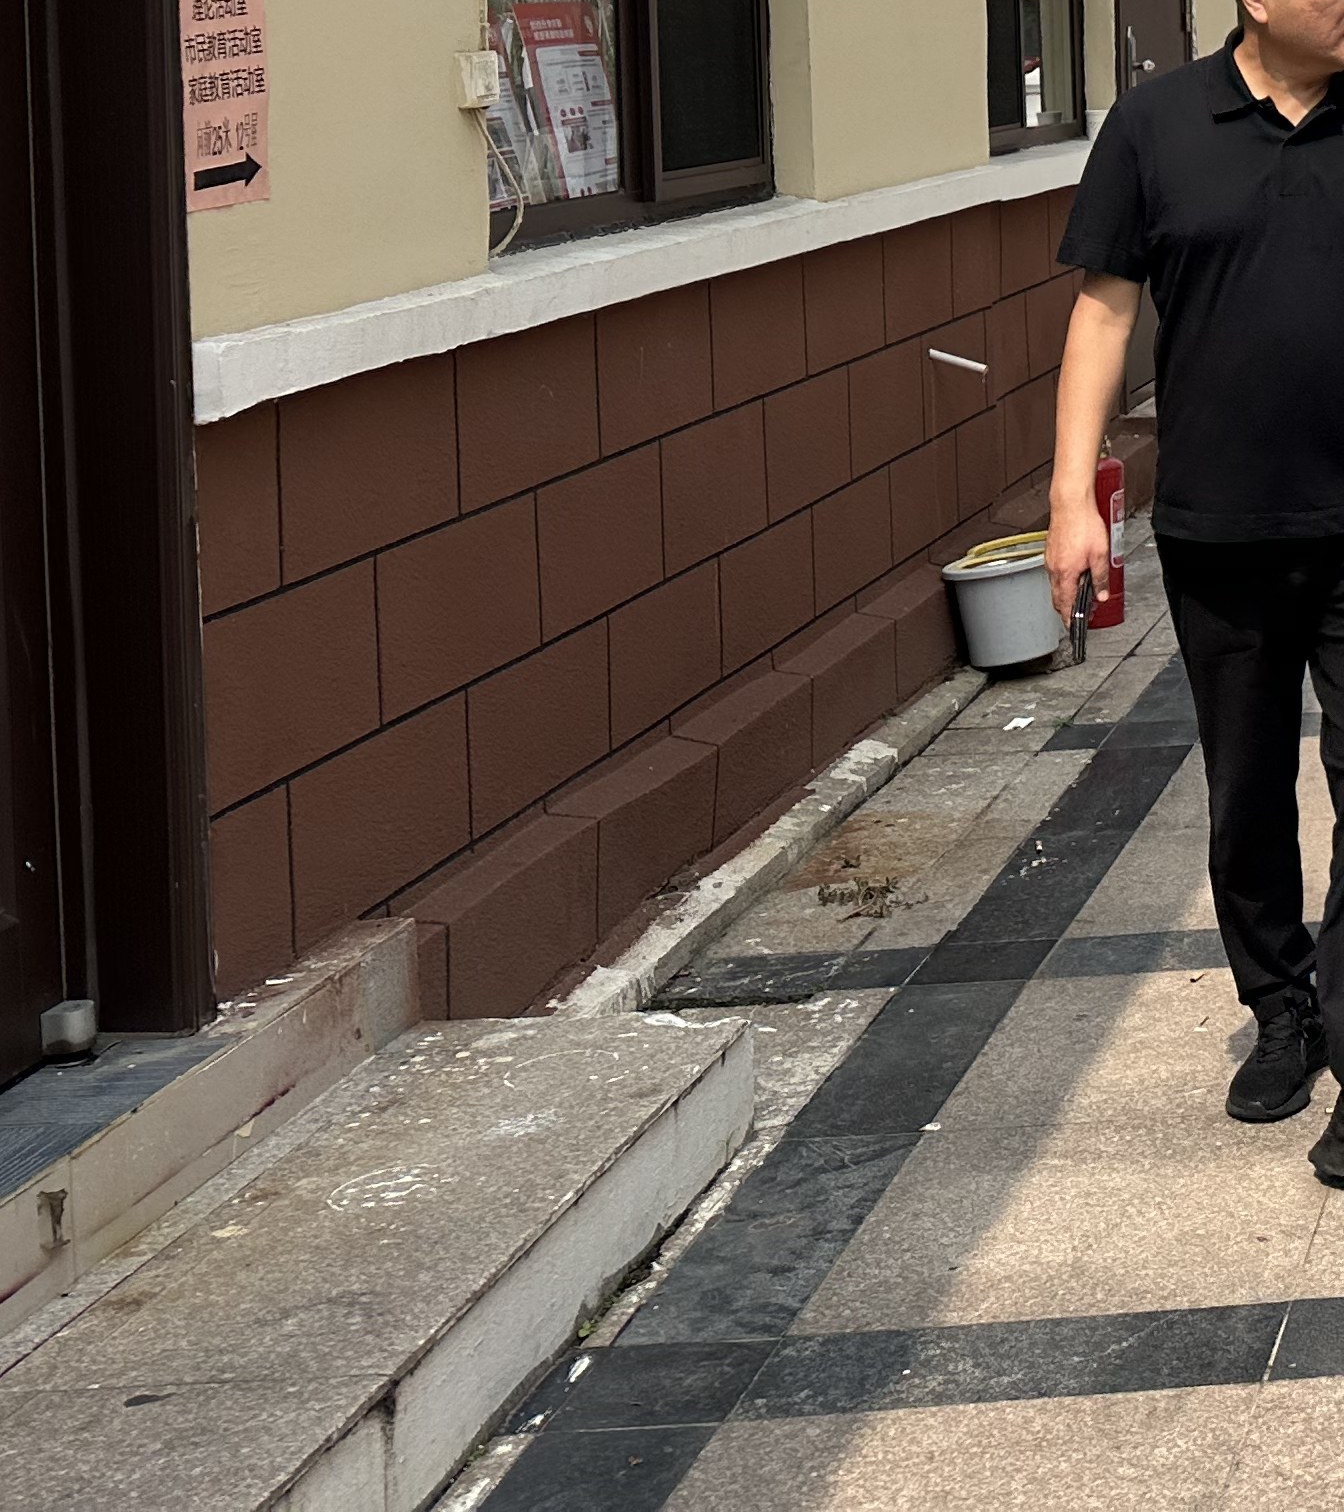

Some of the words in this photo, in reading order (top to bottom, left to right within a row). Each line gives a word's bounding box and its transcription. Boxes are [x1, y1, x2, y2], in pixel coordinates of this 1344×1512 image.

[184, 24, 264, 65] 市民教育活动室
[188, 65, 266, 106] 家庭教育活动室
